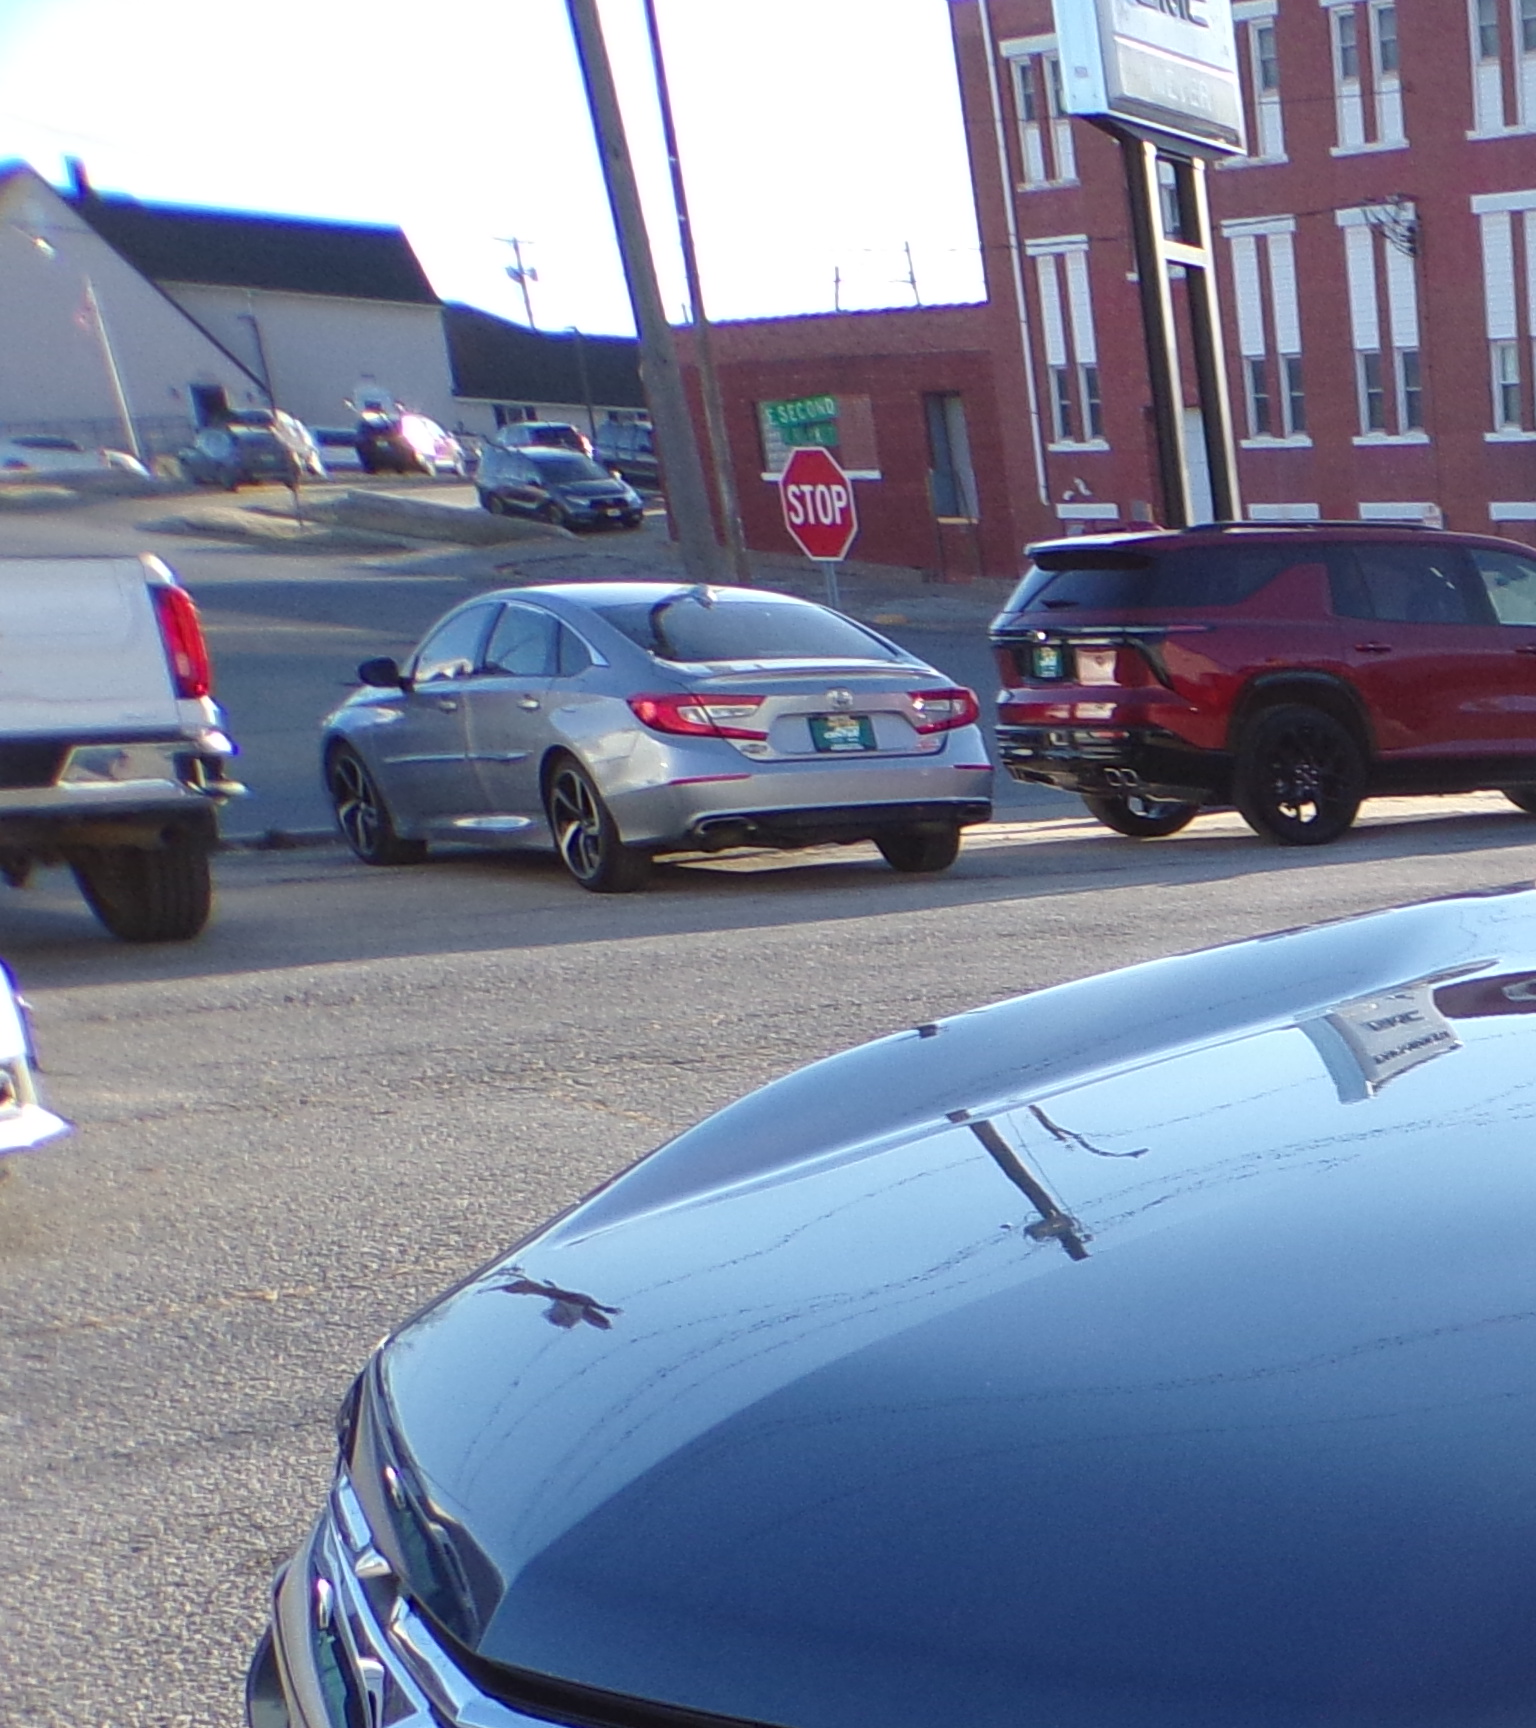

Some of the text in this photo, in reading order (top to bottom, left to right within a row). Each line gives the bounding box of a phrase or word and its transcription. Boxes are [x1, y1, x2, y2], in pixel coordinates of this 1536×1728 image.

[766, 397, 836, 426] E SECOND
[787, 484, 848, 525] STOP
